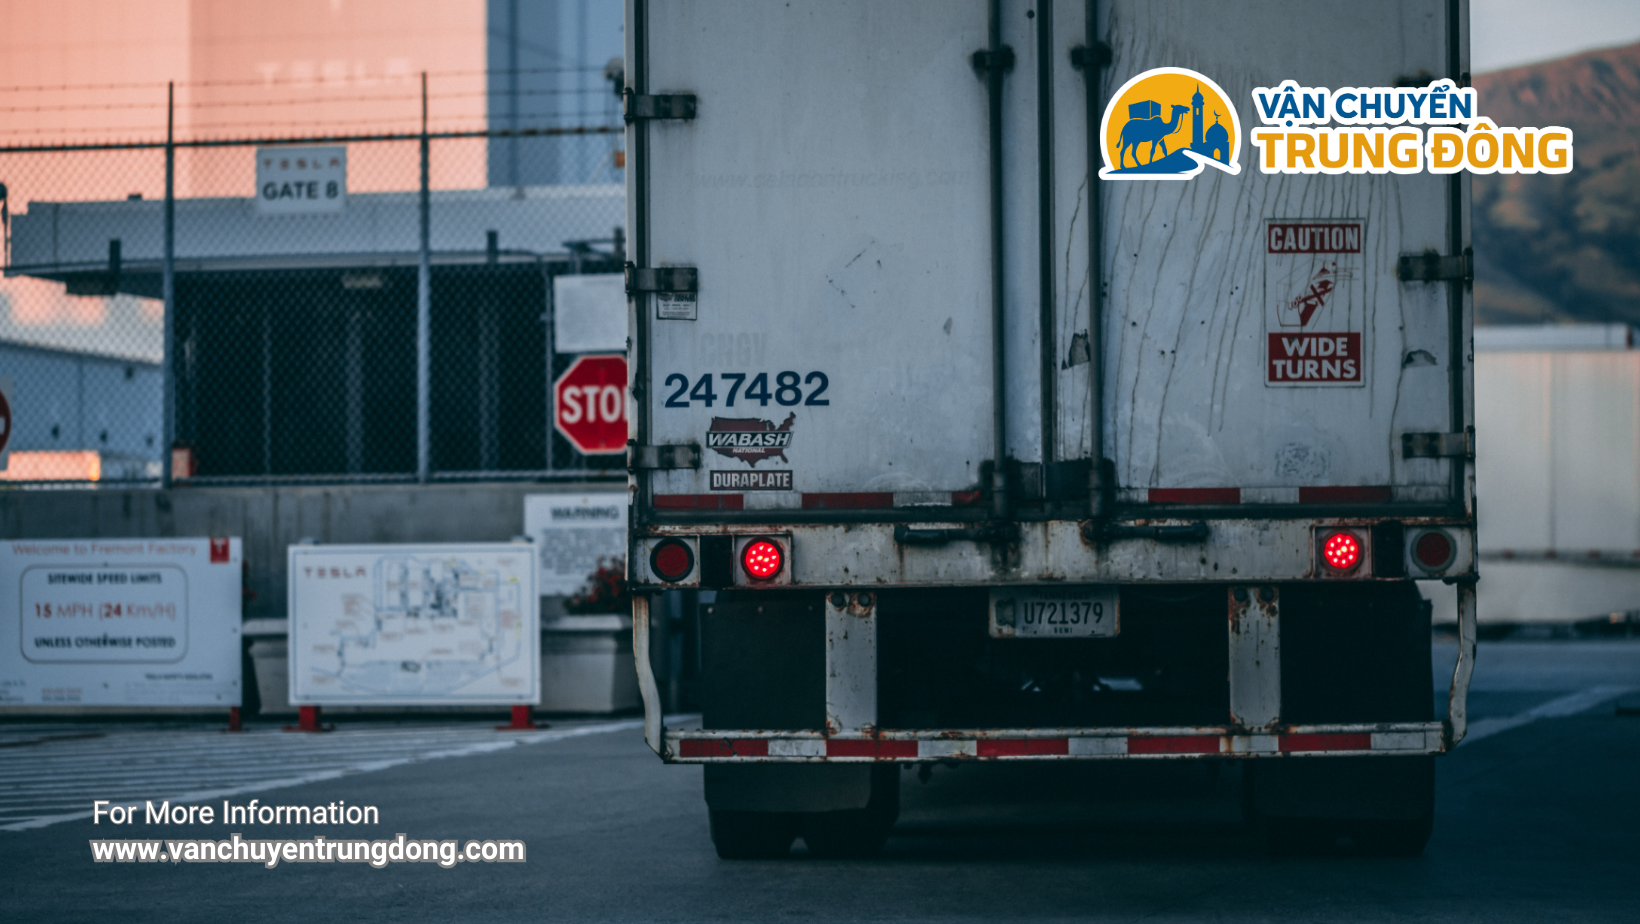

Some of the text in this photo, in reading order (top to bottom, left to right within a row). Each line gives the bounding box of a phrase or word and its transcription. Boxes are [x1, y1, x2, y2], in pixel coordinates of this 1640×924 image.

[262, 180, 339, 201] GATE 8
[1269, 226, 1359, 251] CAUTION
[1281, 337, 1348, 357] WIDE
[1272, 359, 1357, 379] TURNS
[664, 371, 830, 408] 247482
[708, 433, 791, 446] WABASH
[713, 472, 790, 488] DURAPLATE
[12, 543, 197, 557] Welcome to Fremont Factory
[47, 573, 163, 585] SITEWIDE SPEED LIMITS
[303, 566, 367, 579] TESLA
[35, 603, 176, 621] 15 MPH (24 Km/H)
[1023, 602, 1104, 625] U721379
[34, 636, 176, 649] UNLESS OTHERWISE POSTED
